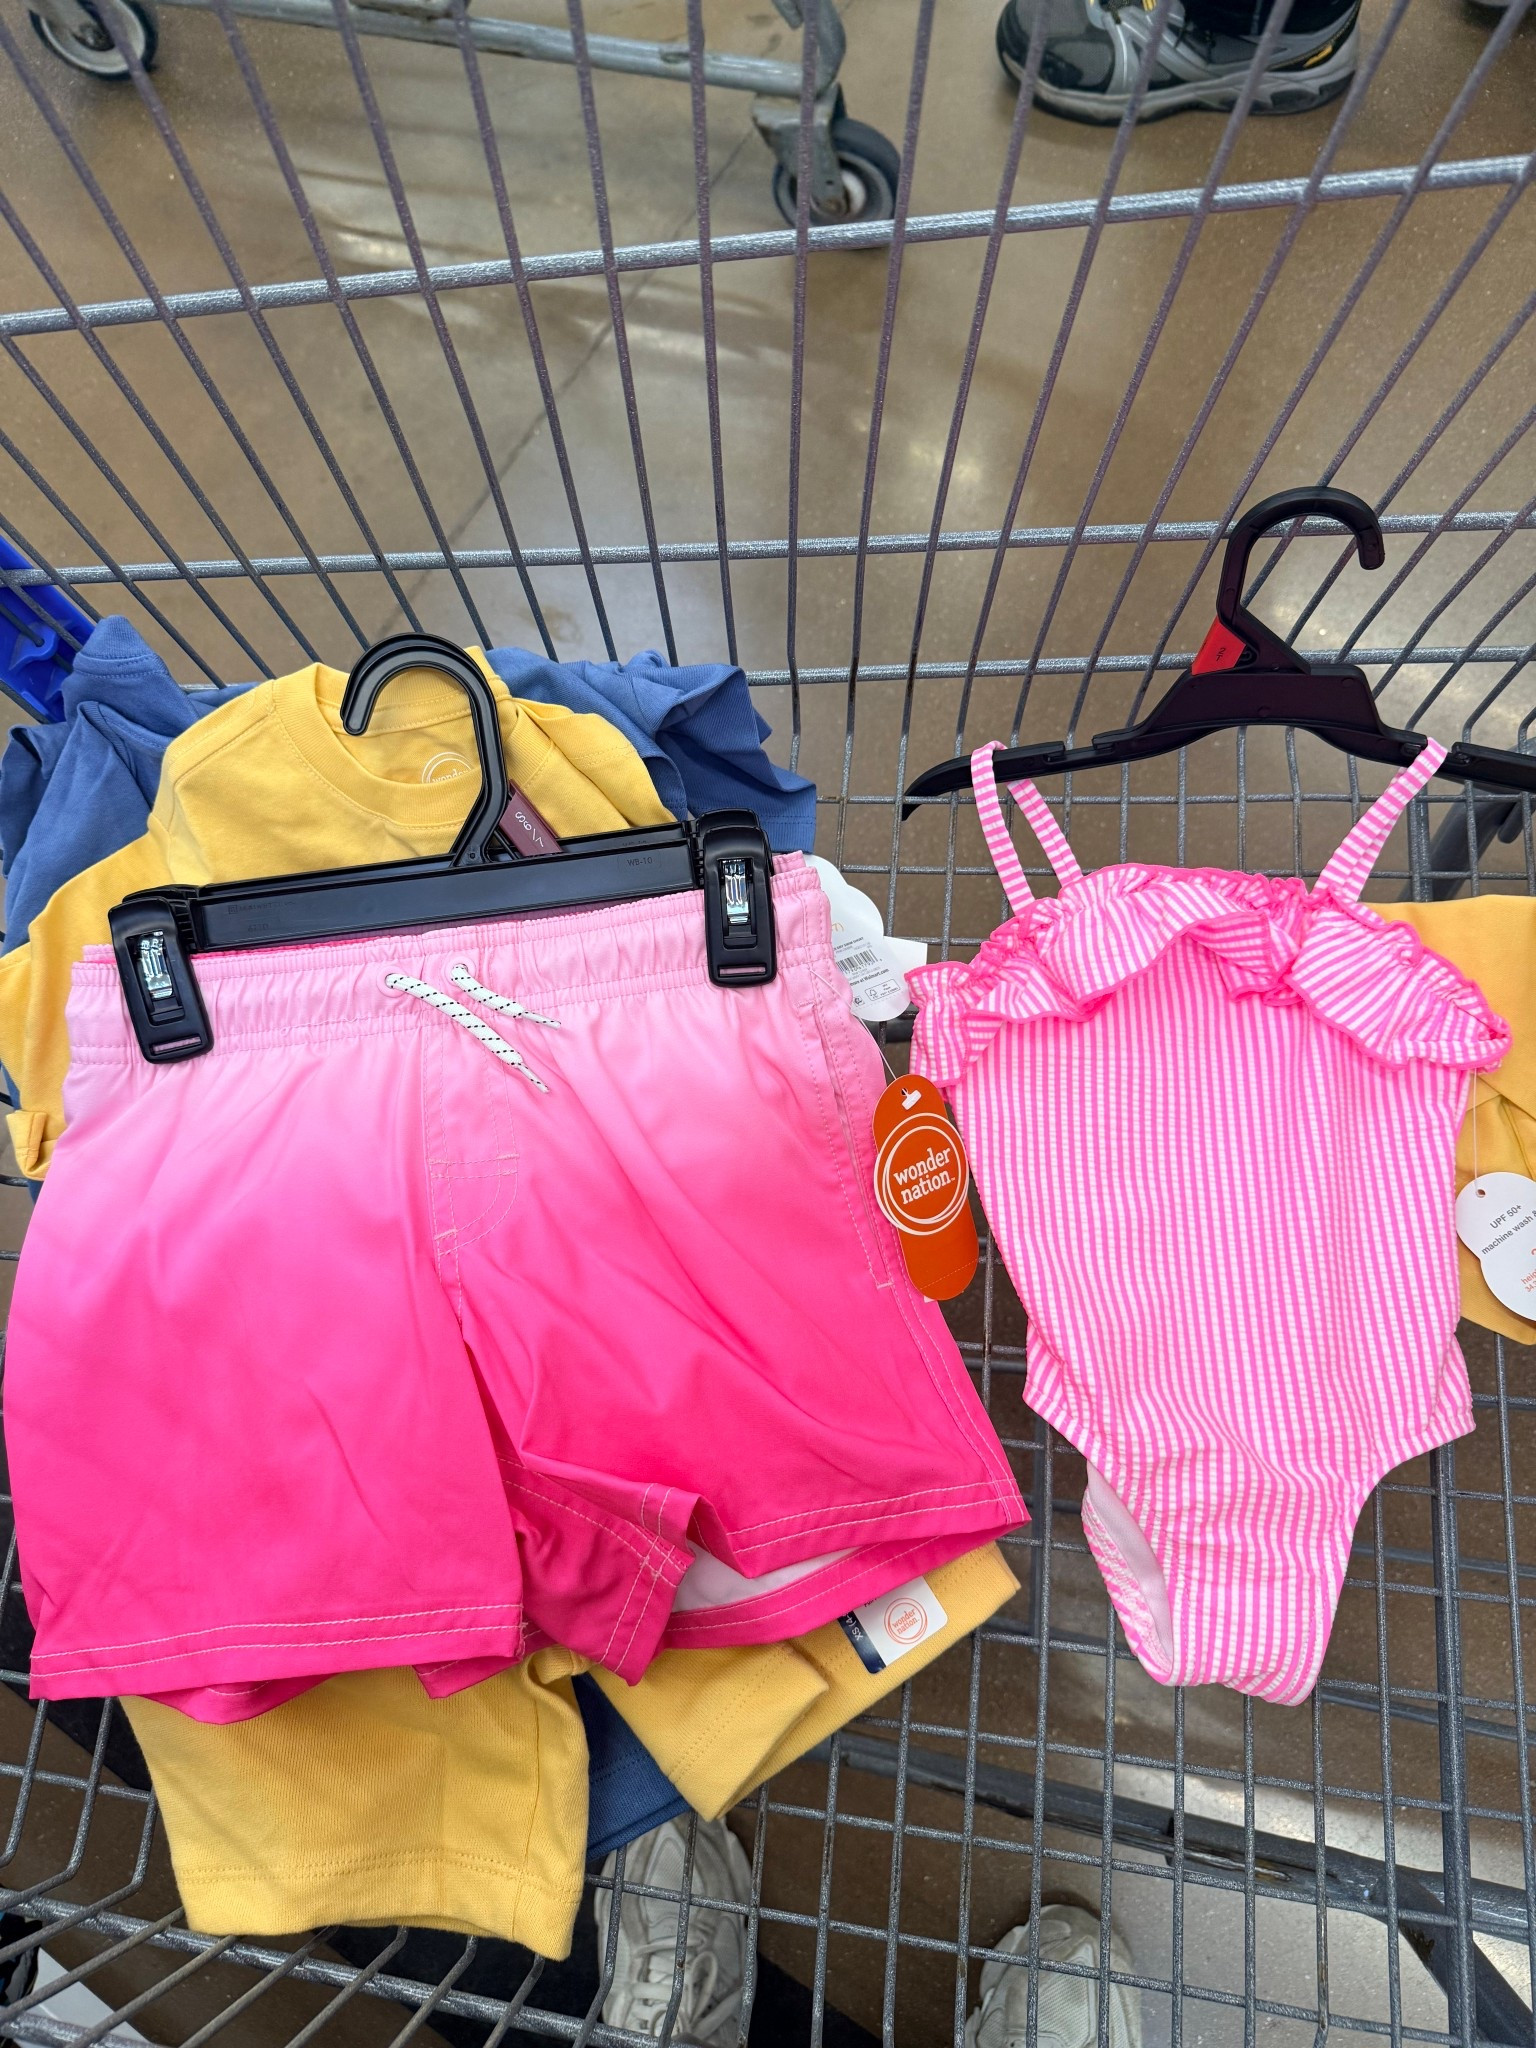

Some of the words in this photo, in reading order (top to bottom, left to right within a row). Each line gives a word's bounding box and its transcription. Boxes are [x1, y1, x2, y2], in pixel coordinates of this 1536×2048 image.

[627, 857, 653, 867] WB-10
[893, 1147, 951, 1186] wonder
[901, 1170, 951, 1205] nation
[1490, 1213, 1507, 1229] UPF
[1506, 1204, 1521, 1217] 50+
[1481, 1230, 1514, 1255] machine
[1512, 1215, 1534, 1232] wash
[892, 1609, 915, 1628] wonder
[897, 1617, 918, 1634] nation
[852, 1626, 863, 1641] XS
